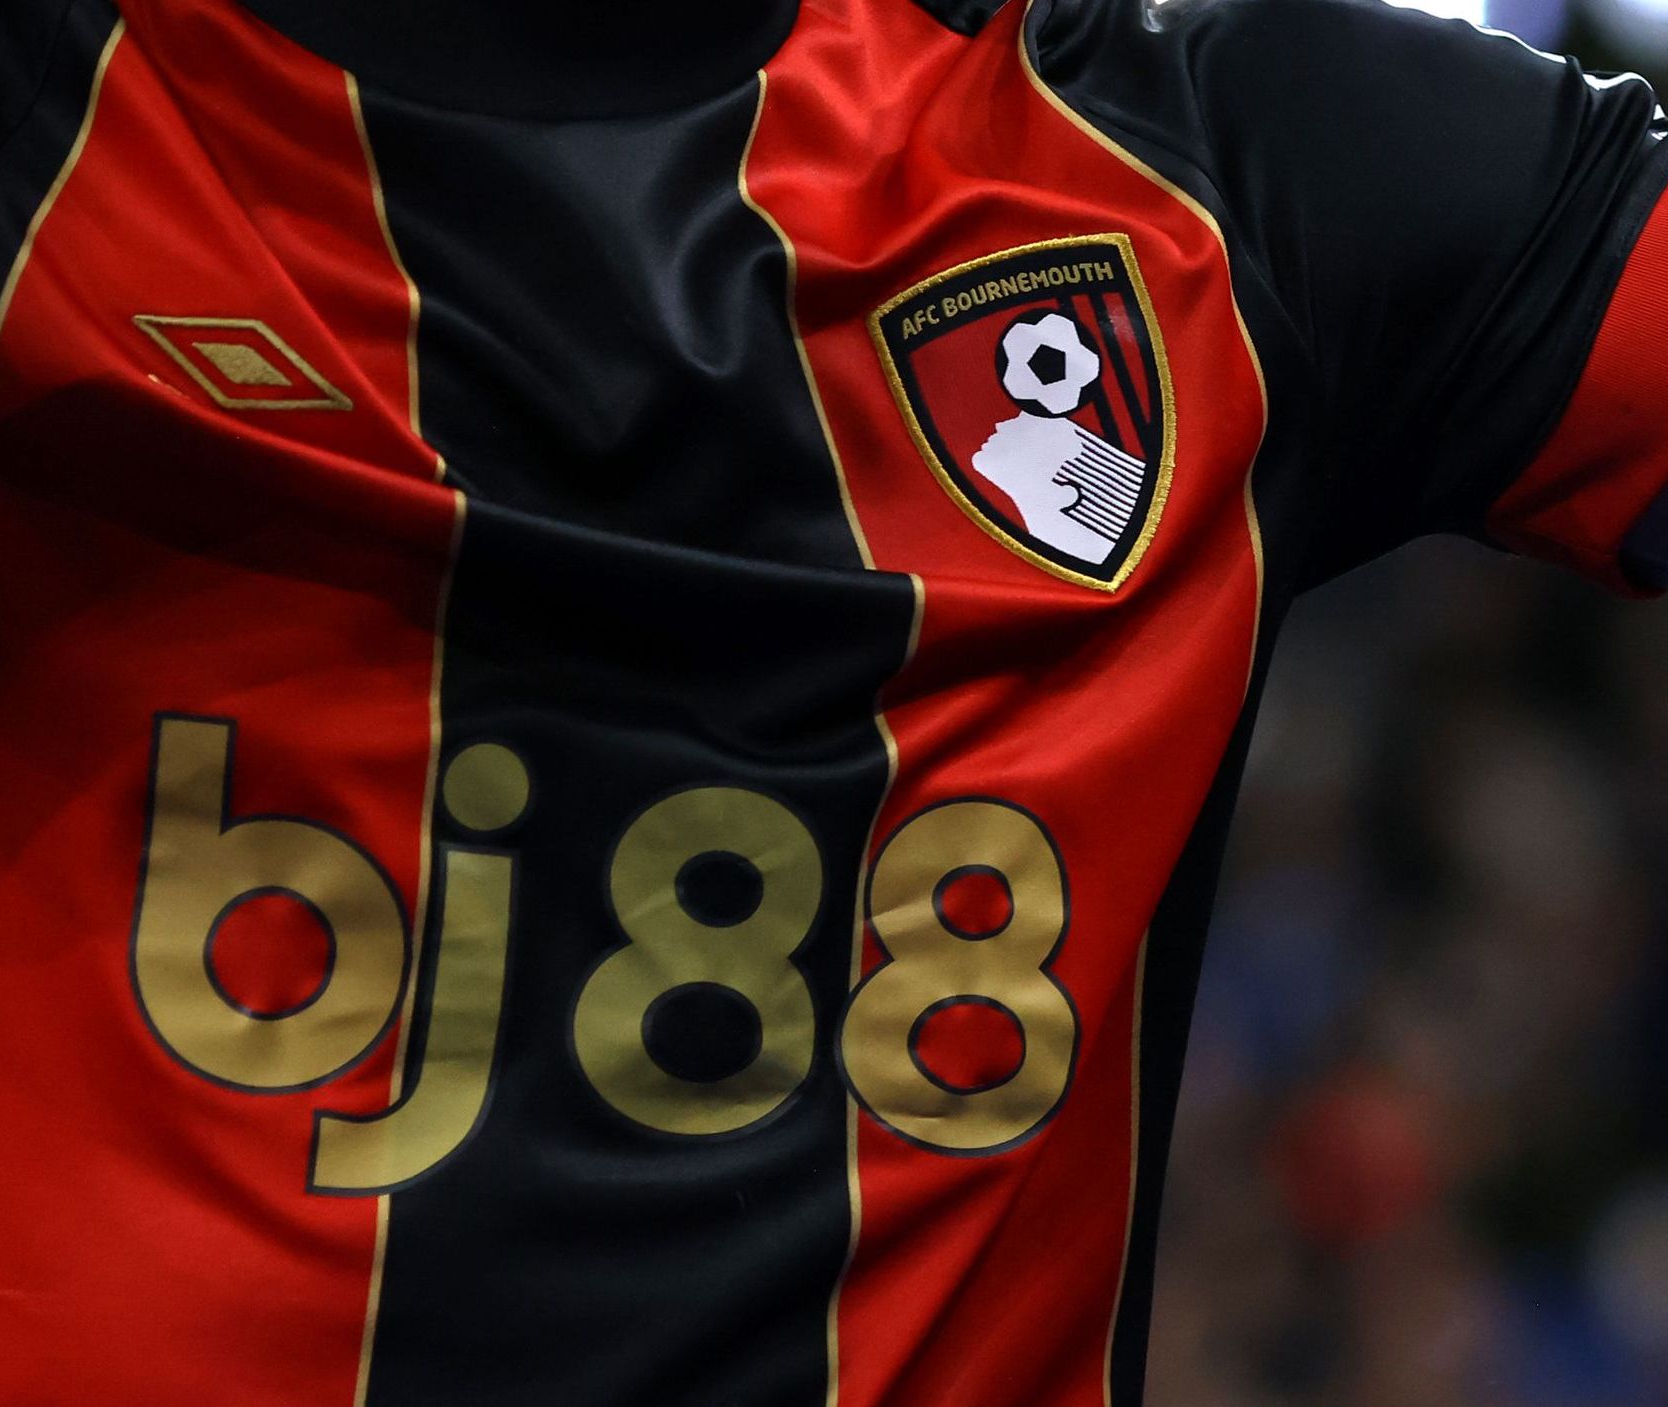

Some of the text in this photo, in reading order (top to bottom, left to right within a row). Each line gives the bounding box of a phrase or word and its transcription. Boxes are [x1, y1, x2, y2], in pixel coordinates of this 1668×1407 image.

[902, 261, 1114, 340] AFC BOURNEMOUTH
[131, 710, 1080, 1194] bj88
